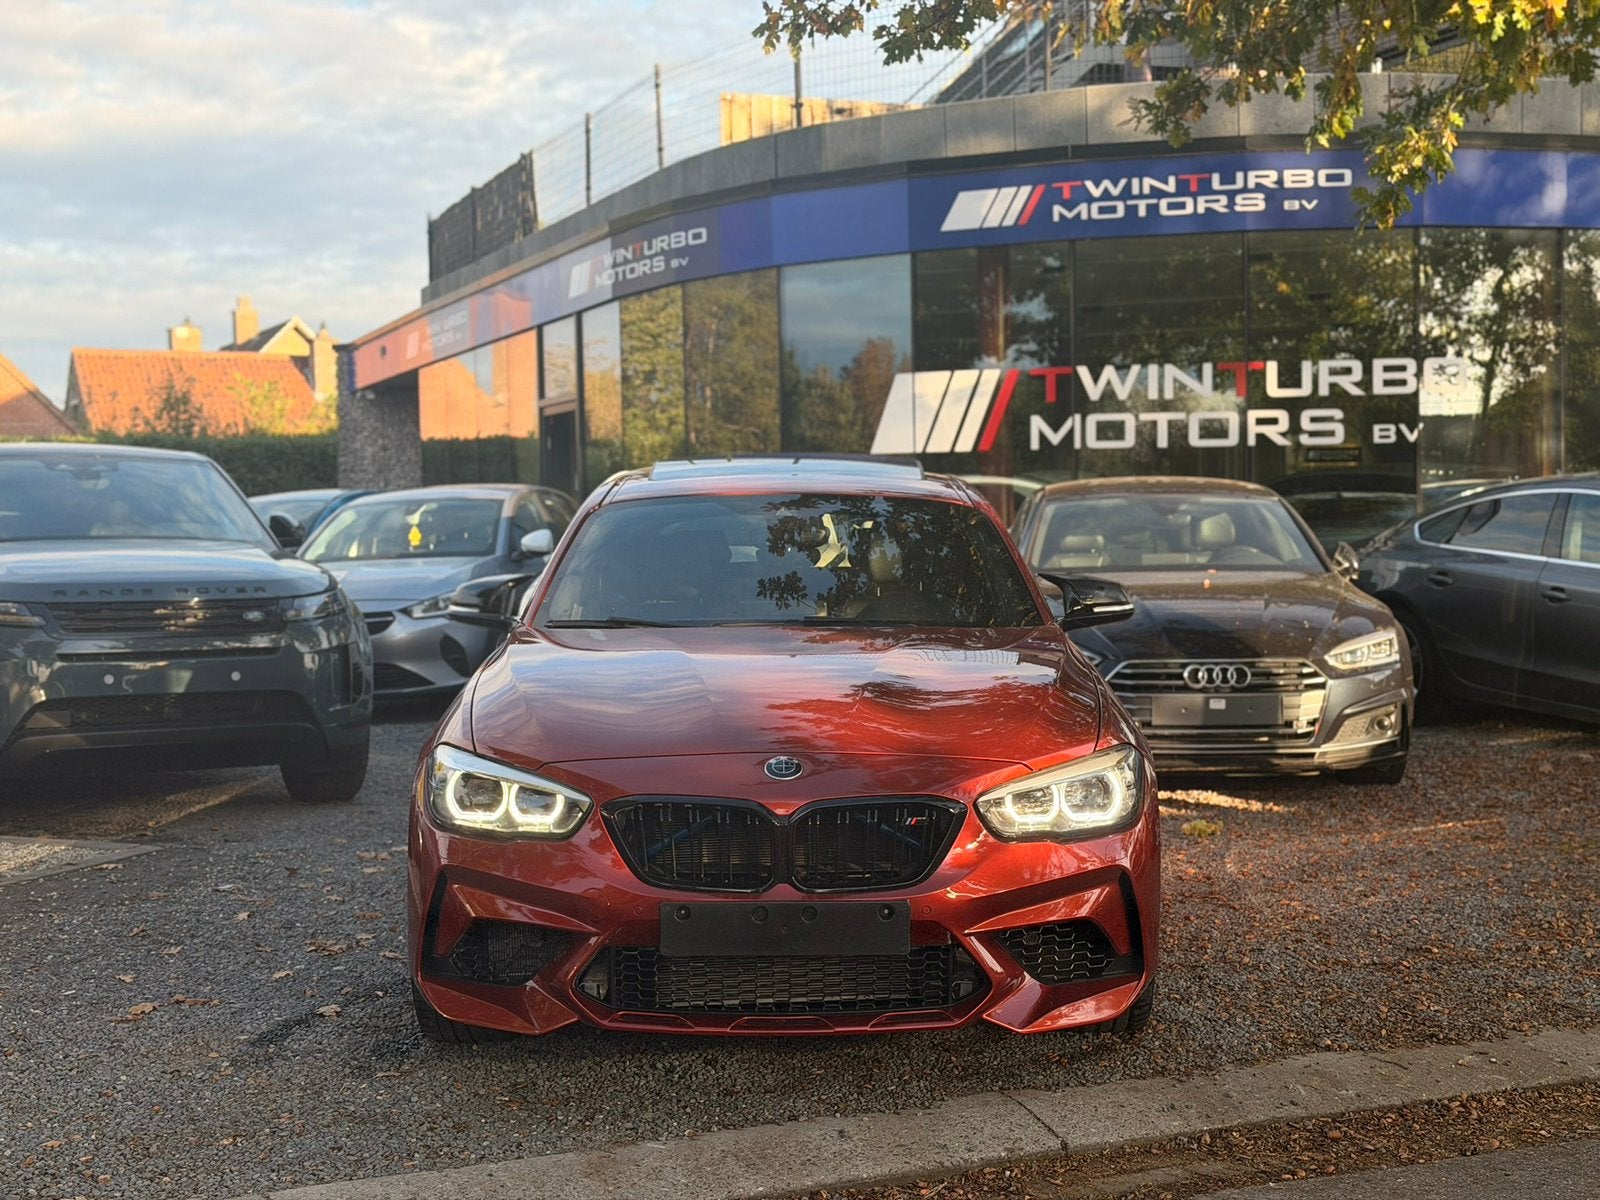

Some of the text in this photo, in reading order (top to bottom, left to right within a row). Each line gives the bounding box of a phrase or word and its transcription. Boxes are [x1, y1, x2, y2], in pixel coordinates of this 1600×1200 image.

[1051, 169, 1353, 199] TWINTURBO
[1052, 193, 1319, 222] MOTORS BV
[670, 257, 690, 269] BV
[1029, 356, 1467, 402] TWINTURBO
[1030, 408, 1424, 450] MOTORS BV
[53, 586, 267, 597] RANGE ROVER
